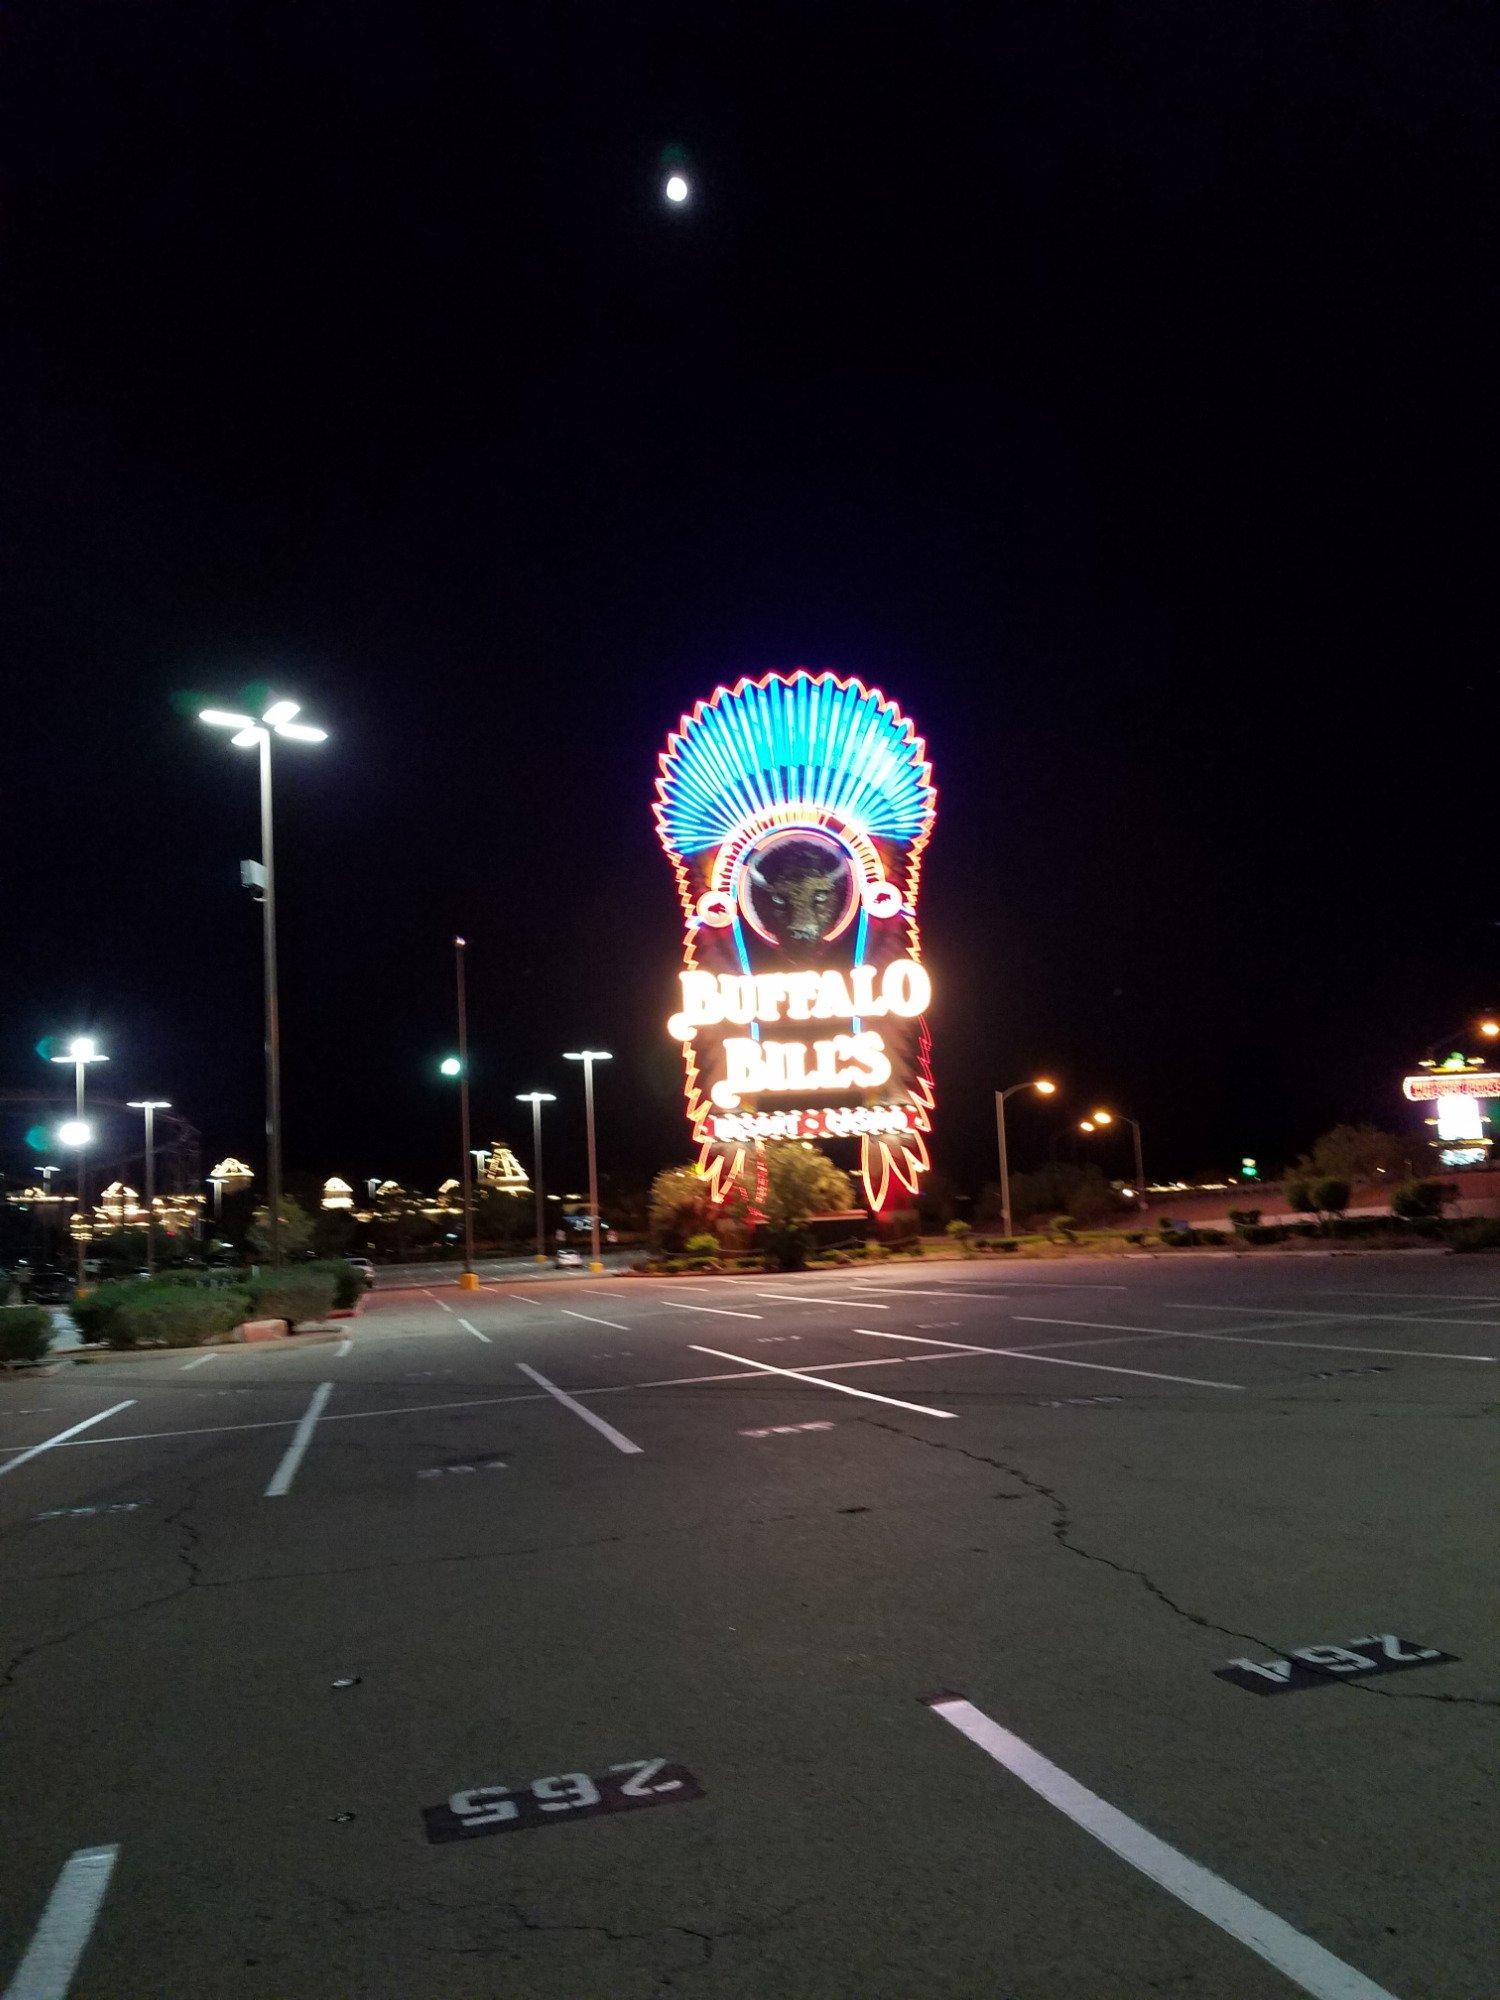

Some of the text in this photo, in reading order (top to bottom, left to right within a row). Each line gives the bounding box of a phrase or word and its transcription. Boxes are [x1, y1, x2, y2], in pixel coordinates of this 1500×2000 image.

[667, 959, 931, 1041] BUFFALO
[1228, 1633, 1441, 1683] 264
[449, 1757, 685, 1828] 265
